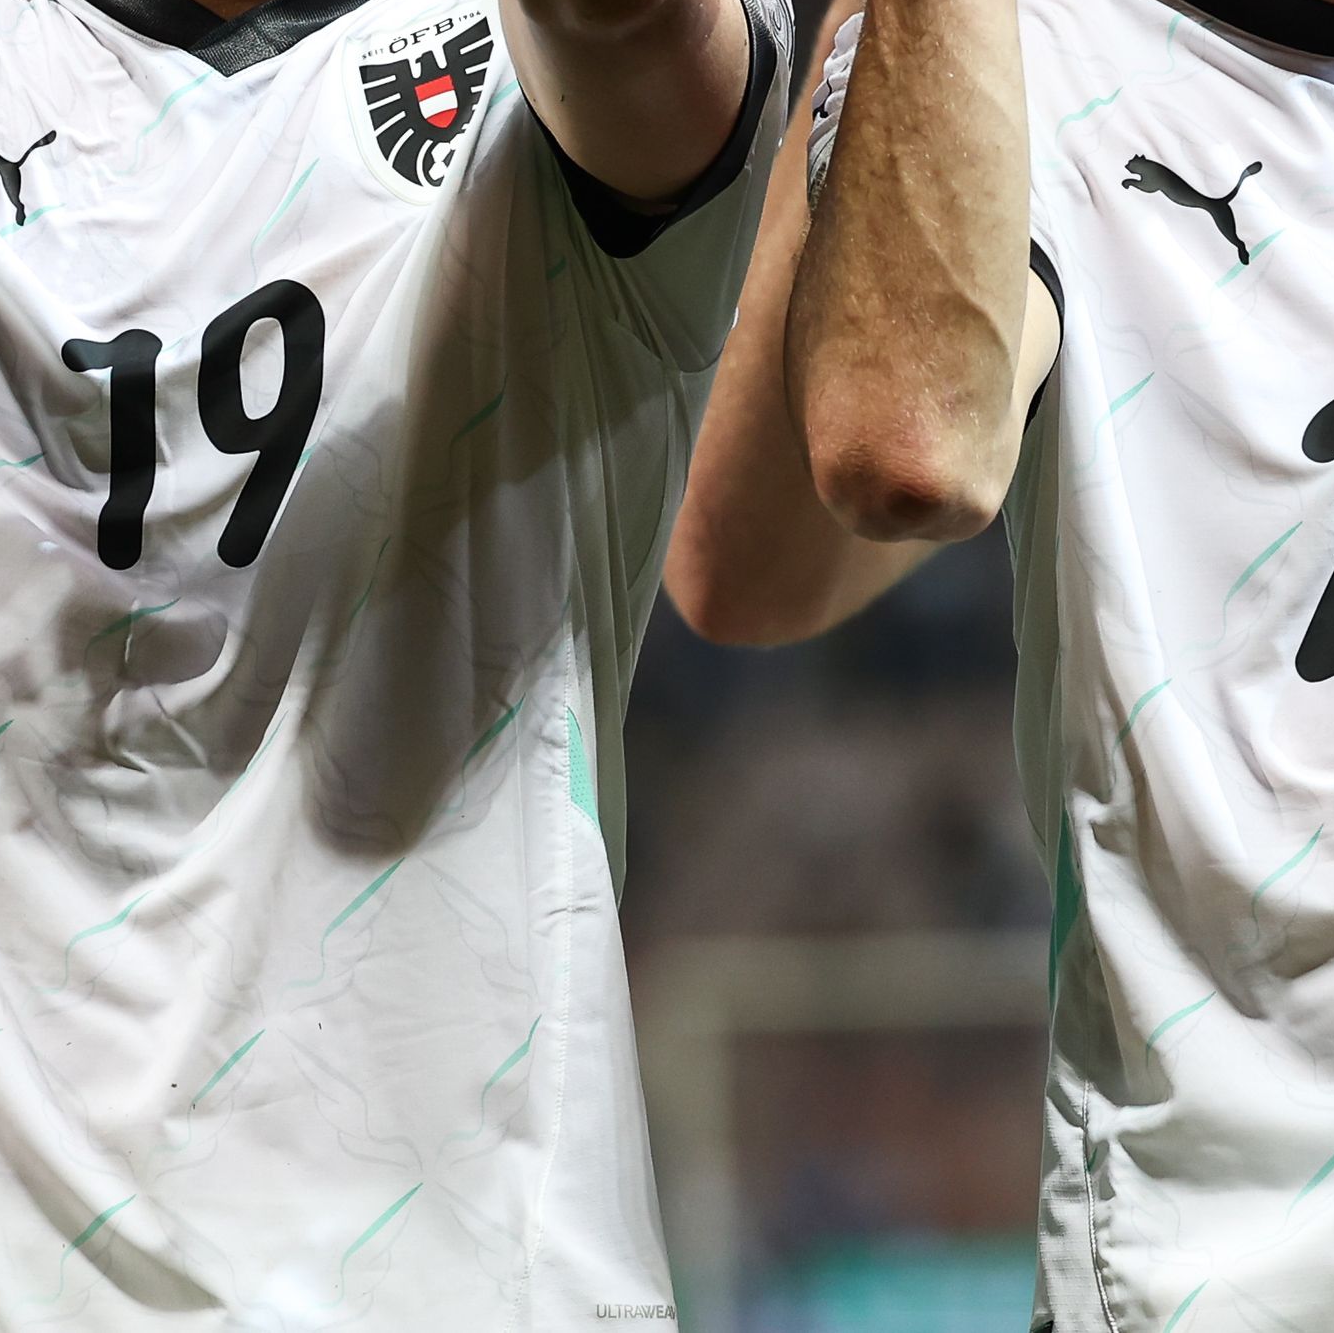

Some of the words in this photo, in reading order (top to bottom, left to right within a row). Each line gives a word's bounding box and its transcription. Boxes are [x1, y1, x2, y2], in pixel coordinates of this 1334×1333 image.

[362, 48, 384, 60] SEIT
[388, 17, 455, 54] ÖFB
[61, 280, 325, 570] 19
[596, 1303, 676, 1320] ULTRAWEAV
